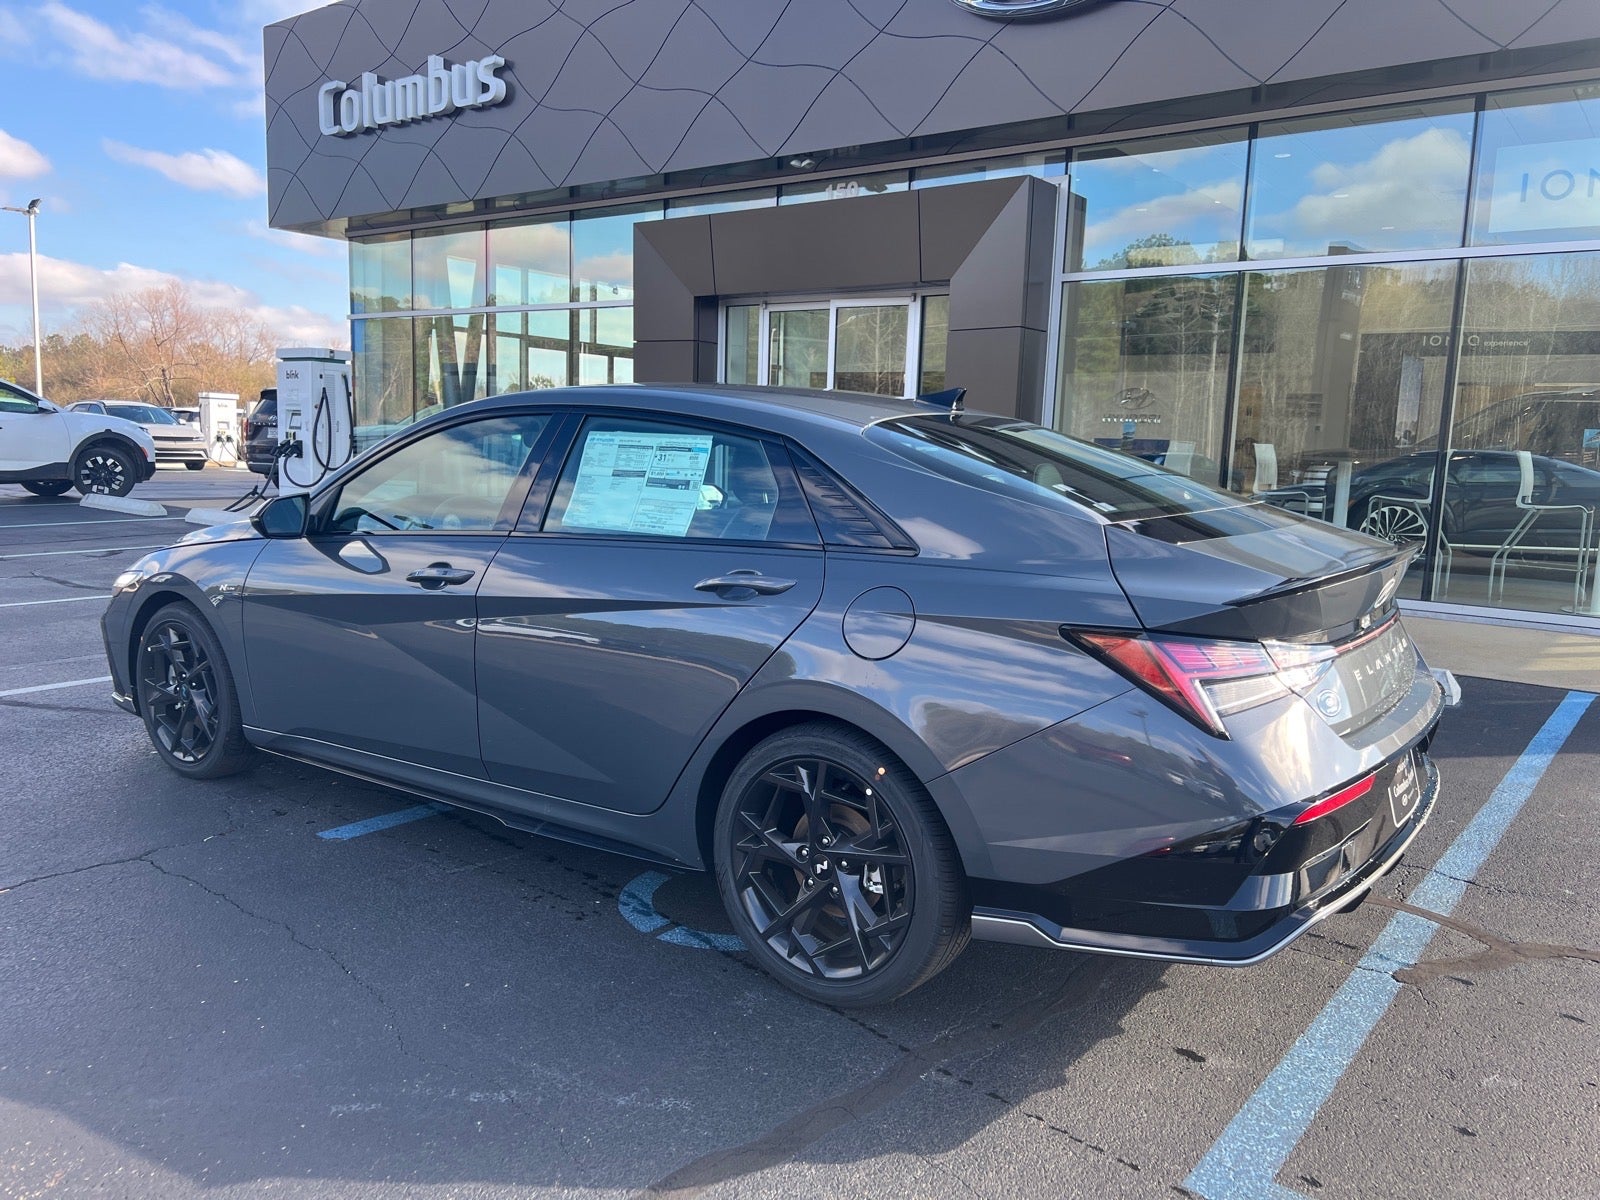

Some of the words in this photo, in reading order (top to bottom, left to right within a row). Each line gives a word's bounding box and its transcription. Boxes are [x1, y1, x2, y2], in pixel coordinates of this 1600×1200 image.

[318, 54, 506, 136] Columbus
[825, 181, 860, 200] 150
[1483, 340, 1529, 348] experience
[286, 370, 299, 379] blink
